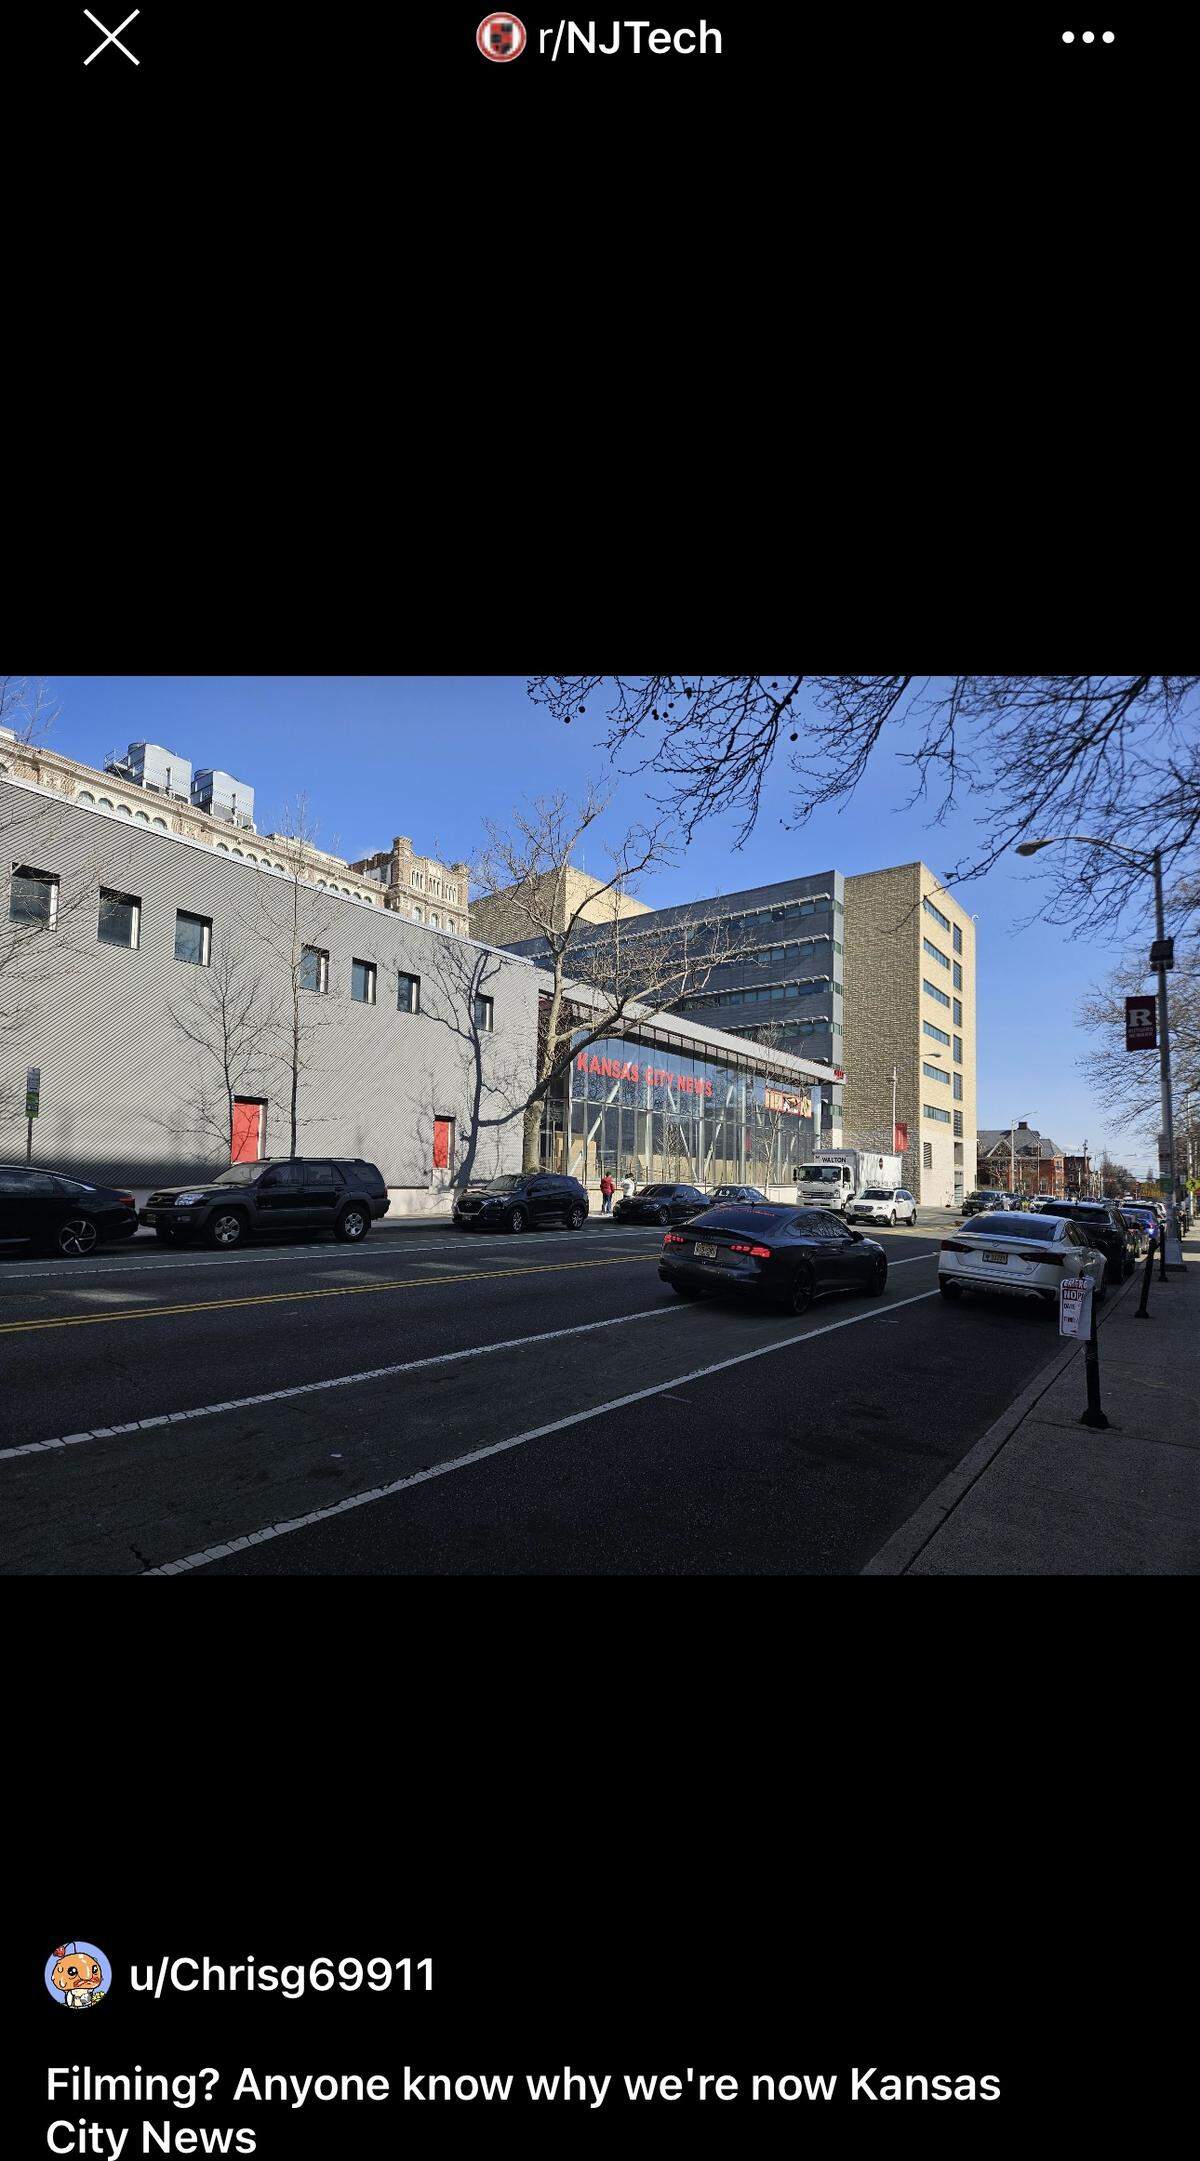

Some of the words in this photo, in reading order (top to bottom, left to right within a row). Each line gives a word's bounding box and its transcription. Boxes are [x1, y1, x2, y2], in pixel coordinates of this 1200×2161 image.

[1128, 1009, 1152, 1027] R
[577, 1052, 638, 1082] KANSAS
[645, 1066, 674, 1088] CITY
[677, 1075, 713, 1097] NEWS
